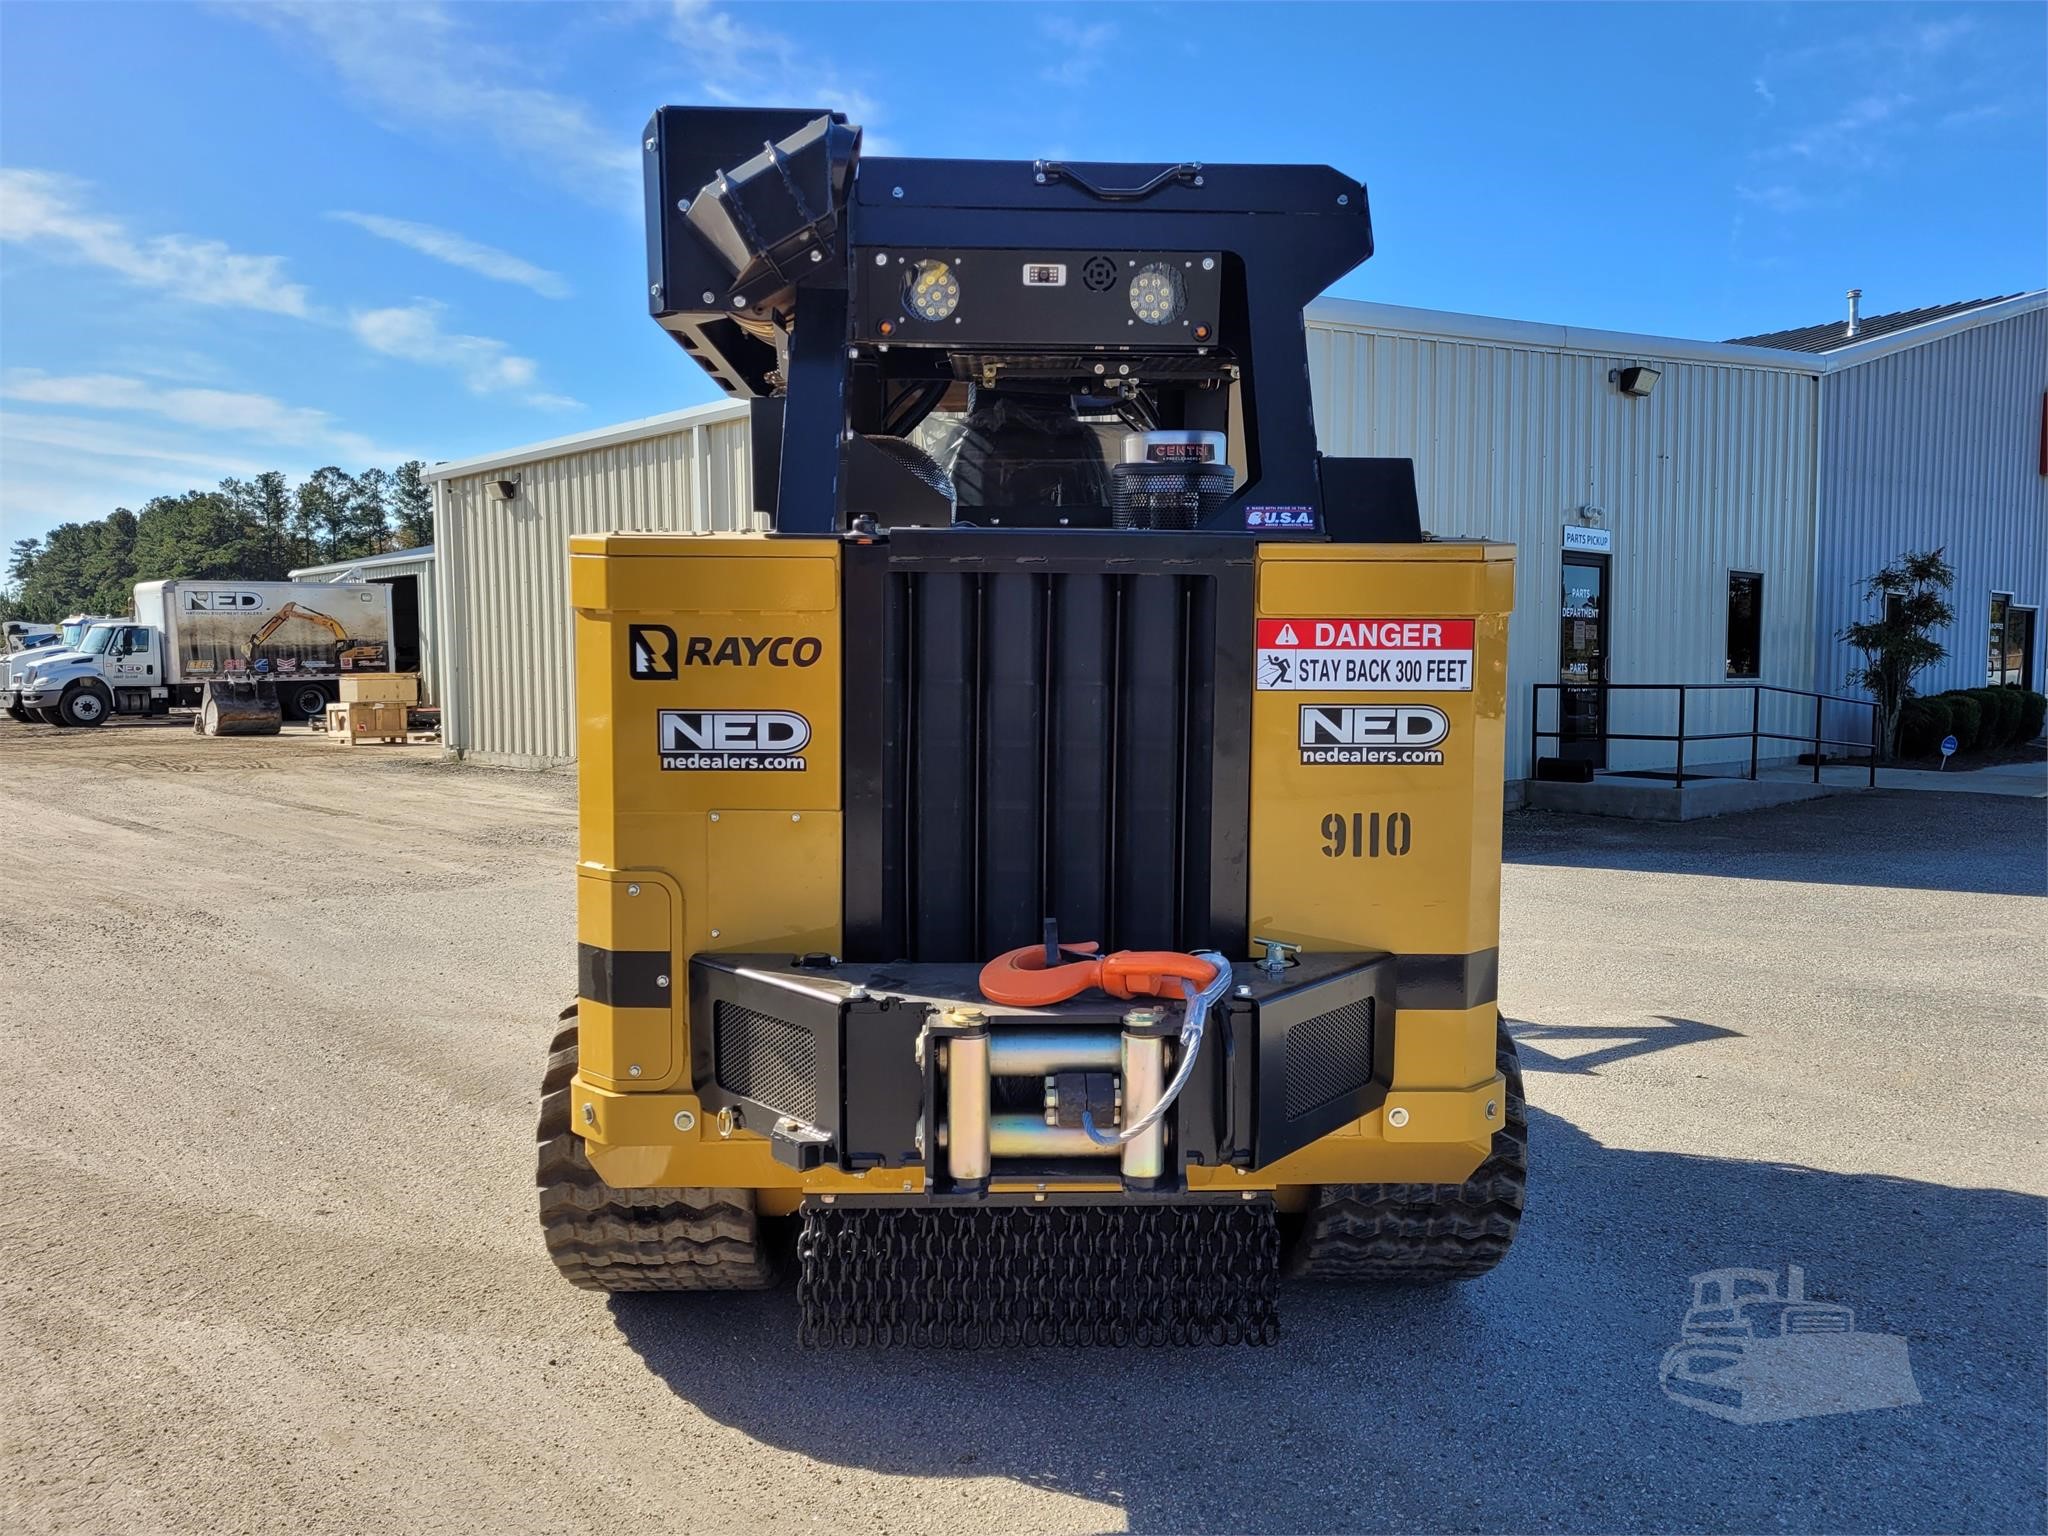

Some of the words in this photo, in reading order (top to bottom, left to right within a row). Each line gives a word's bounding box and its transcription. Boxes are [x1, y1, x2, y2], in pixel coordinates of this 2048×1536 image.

[1156, 445, 1209, 456] CENTRI
[1264, 512, 1313, 524] U.S.A.
[1566, 532, 1586, 545] PARTS
[1586, 535, 1609, 546] PICKUP
[184, 591, 263, 610] NED
[1571, 587, 1591, 599] PARTS
[1562, 607, 1599, 618] DEPARTMENT
[1315, 623, 1442, 648] DANGER
[684, 636, 823, 668] RAYCO
[115, 664, 144, 673] NED
[1299, 659, 1341, 682] STAY
[1346, 659, 1391, 682] BACK
[1395, 659, 1422, 683] 300
[1426, 659, 1468, 683] FEET
[1569, 663, 1588, 673] PARTS
[662, 714, 808, 750] NED
[1303, 708, 1446, 744] NED
[662, 754, 805, 769] nedealers.com
[1302, 747, 1442, 763] nedealers.com
[1321, 811, 1411, 857] 9110
